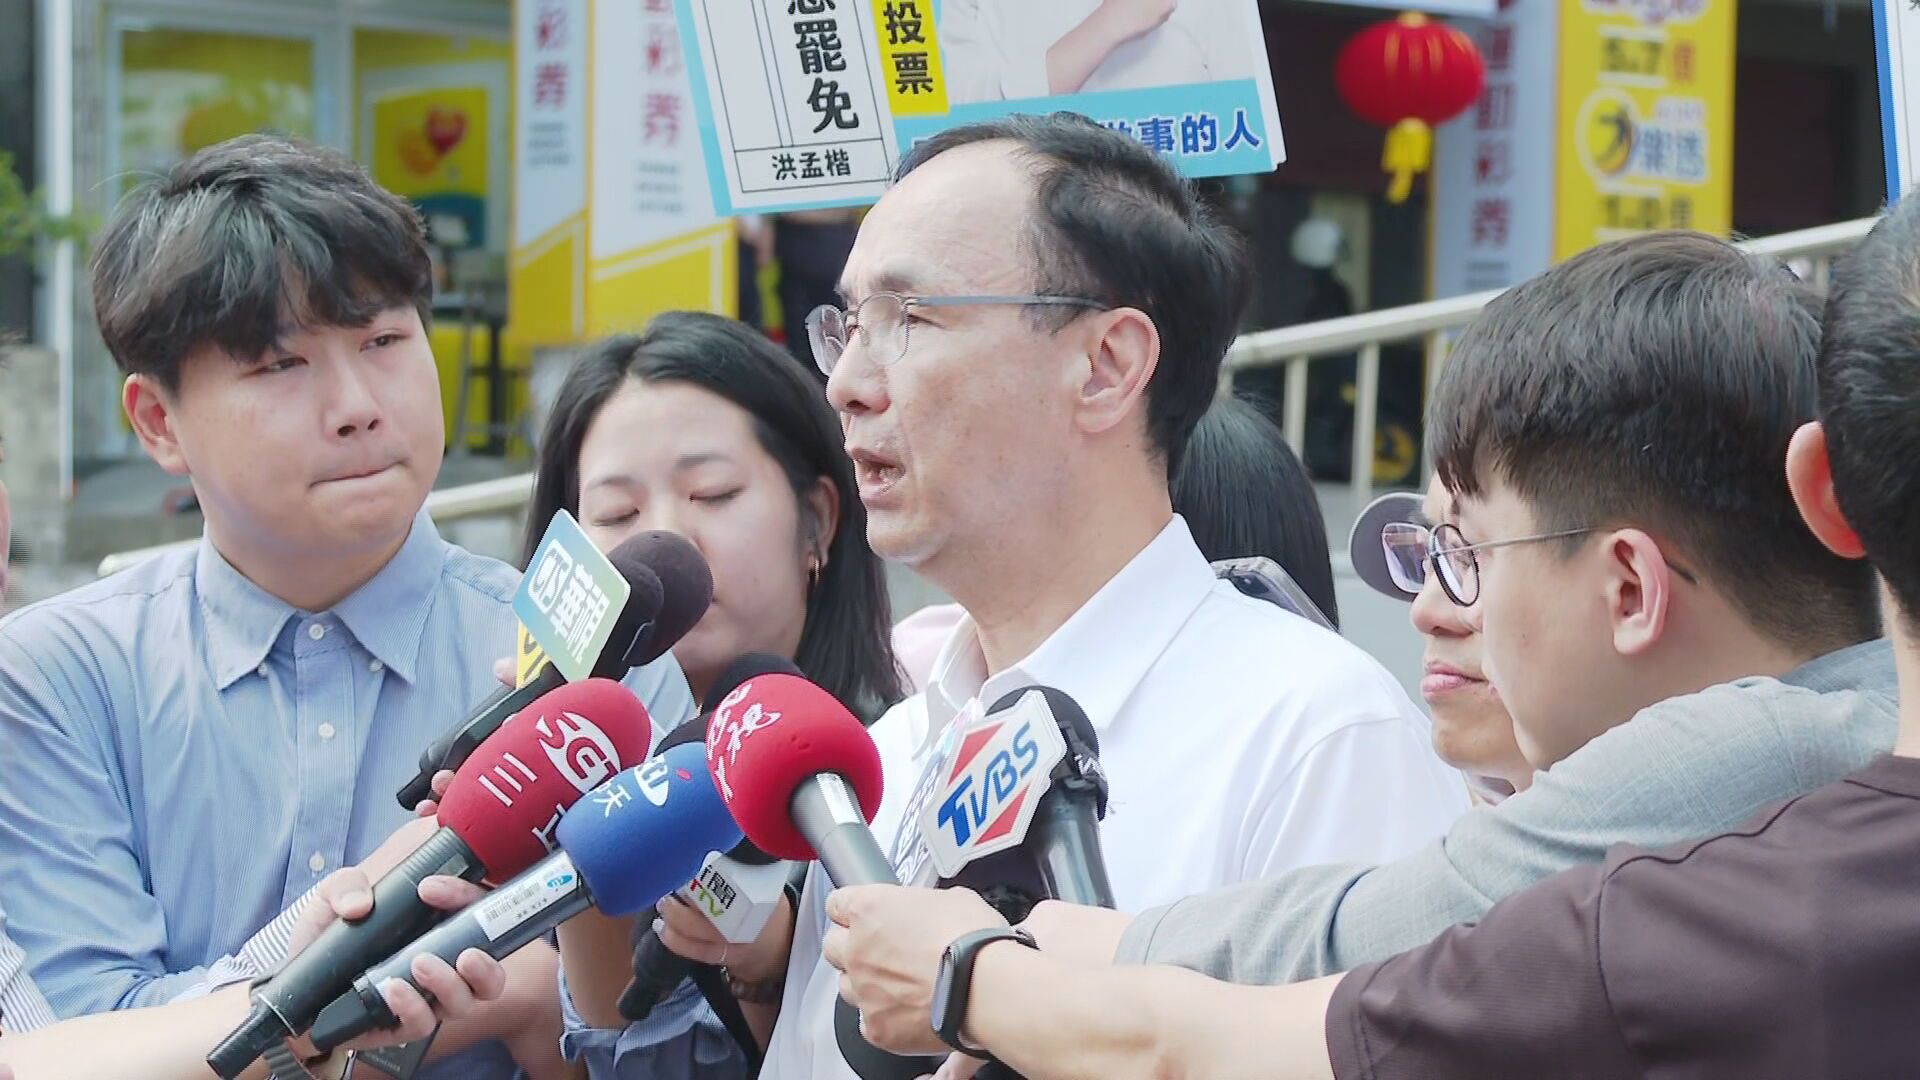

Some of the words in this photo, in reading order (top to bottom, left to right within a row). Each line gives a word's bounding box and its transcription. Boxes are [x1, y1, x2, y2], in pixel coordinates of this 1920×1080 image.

[643, 0, 683, 146] 彩券
[883, 1, 933, 95] 投票
[771, 149, 851, 181] 洪孟楷
[937, 721, 1039, 847] TVBS
